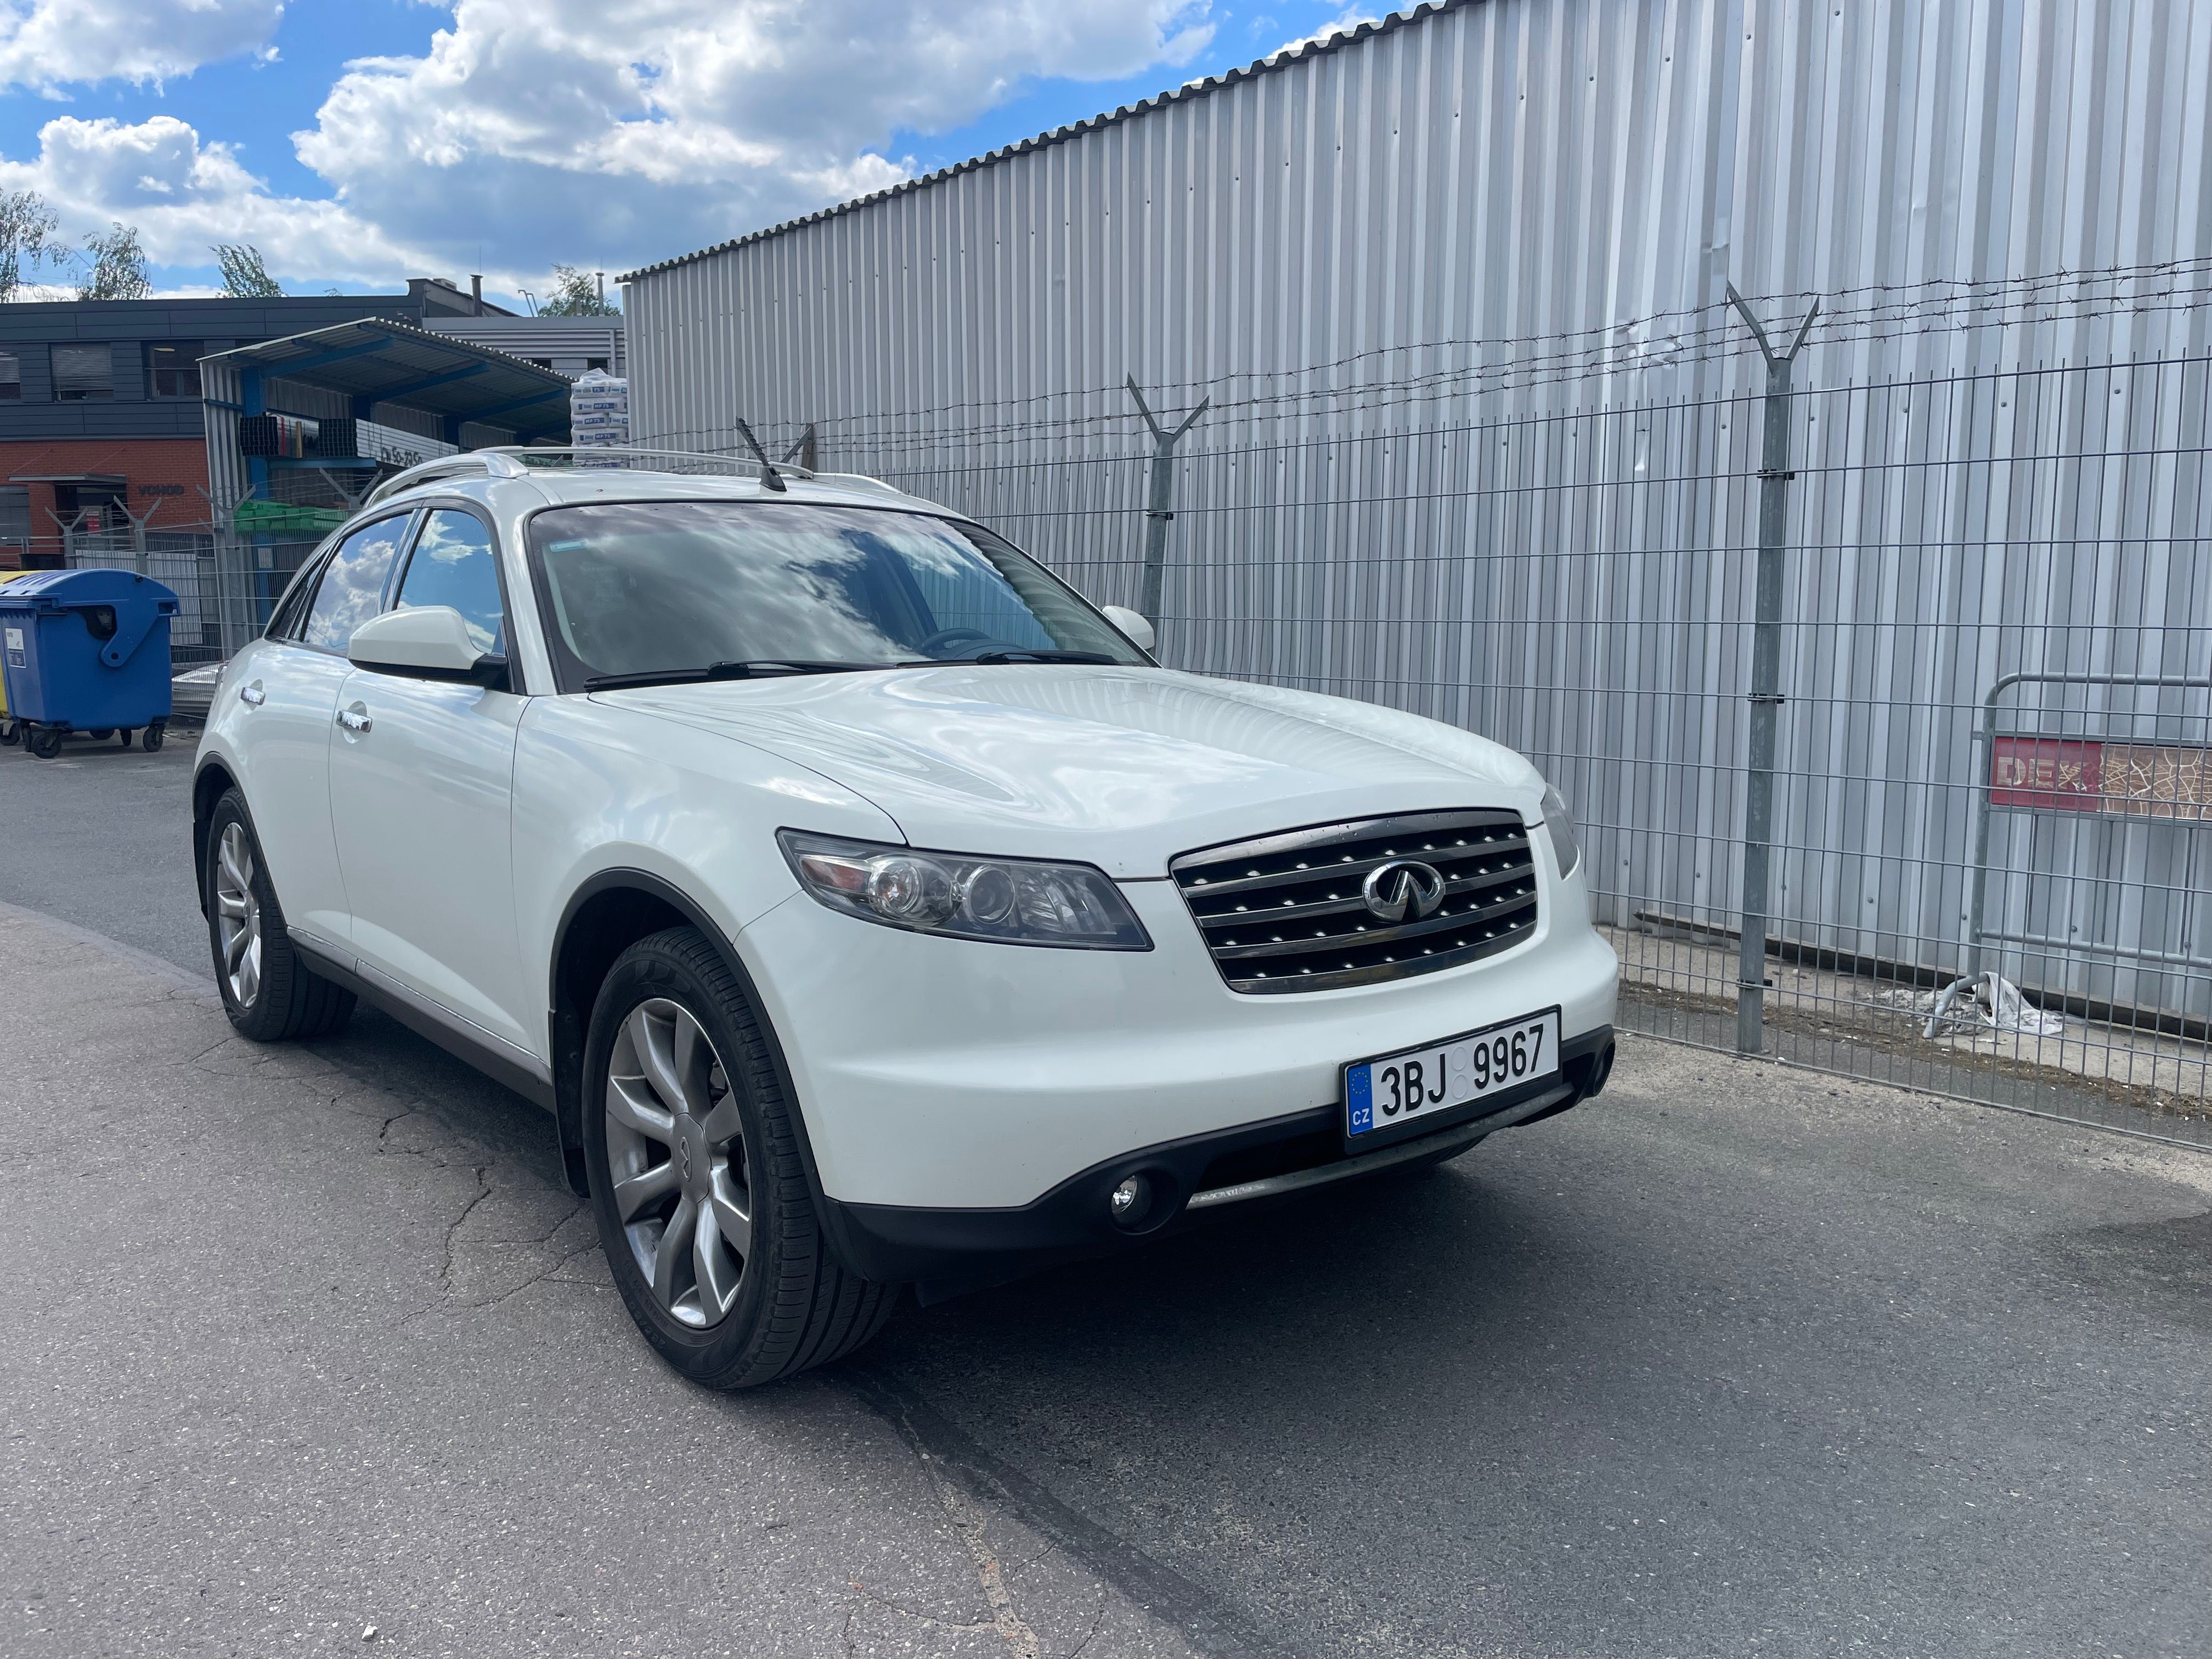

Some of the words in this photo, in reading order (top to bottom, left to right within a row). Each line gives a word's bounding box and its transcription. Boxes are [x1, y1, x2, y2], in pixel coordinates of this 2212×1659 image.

[1381, 1053, 1446, 1116] 3BJ
[1474, 1023, 1543, 1090] 9967
[1353, 1108, 1369, 1125] CZ
